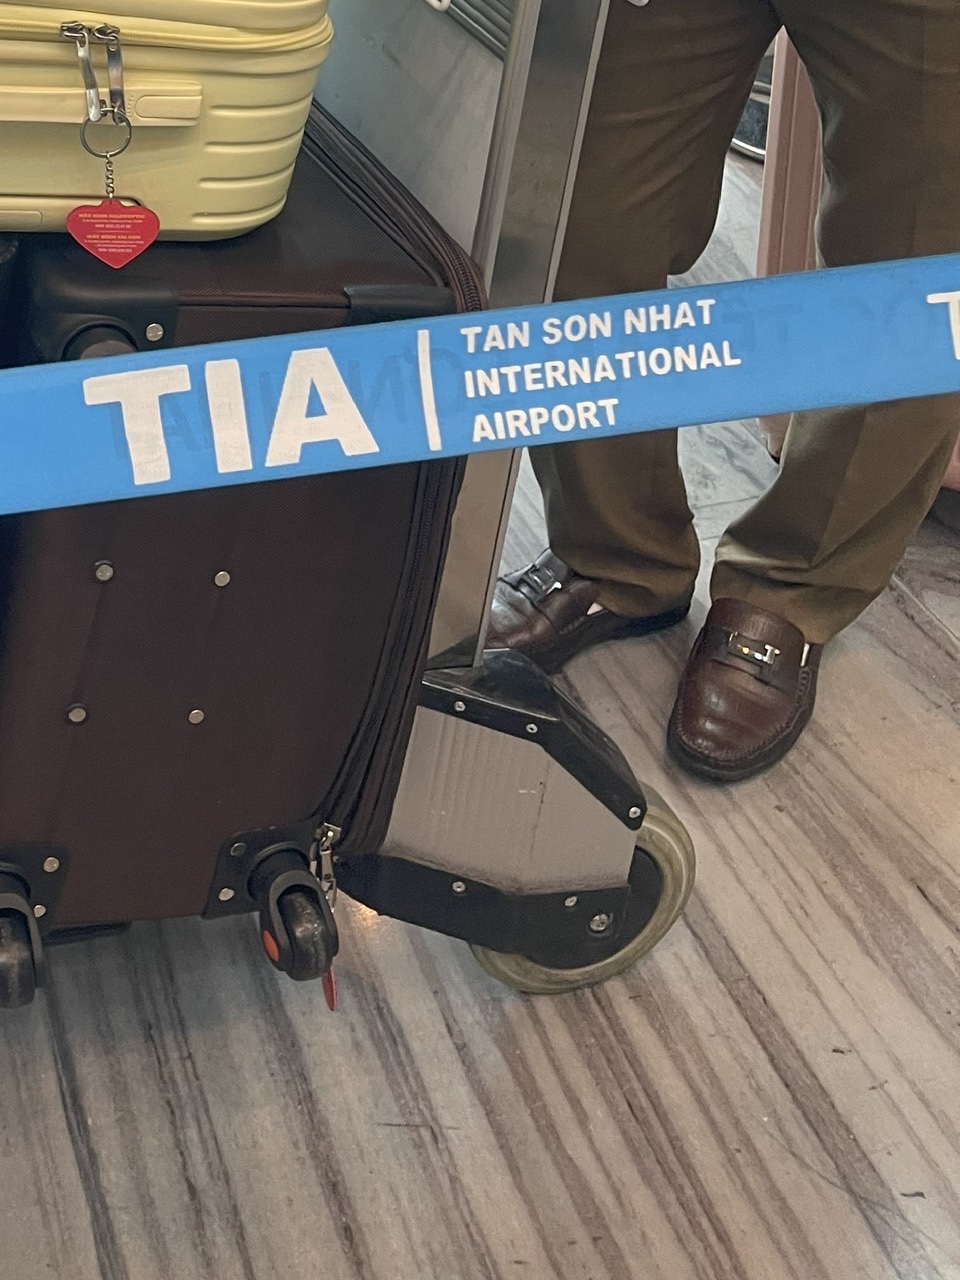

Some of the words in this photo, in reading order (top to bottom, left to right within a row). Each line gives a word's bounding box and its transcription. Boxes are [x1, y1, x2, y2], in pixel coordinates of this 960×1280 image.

[460, 321, 530, 354] TAN
[542, 311, 612, 345] SON
[624, 299, 716, 335] NHAT
[464, 340, 742, 398] INTERNATIONAL
[83, 347, 380, 486] TIA
[472, 398, 619, 442] AIRPORT
